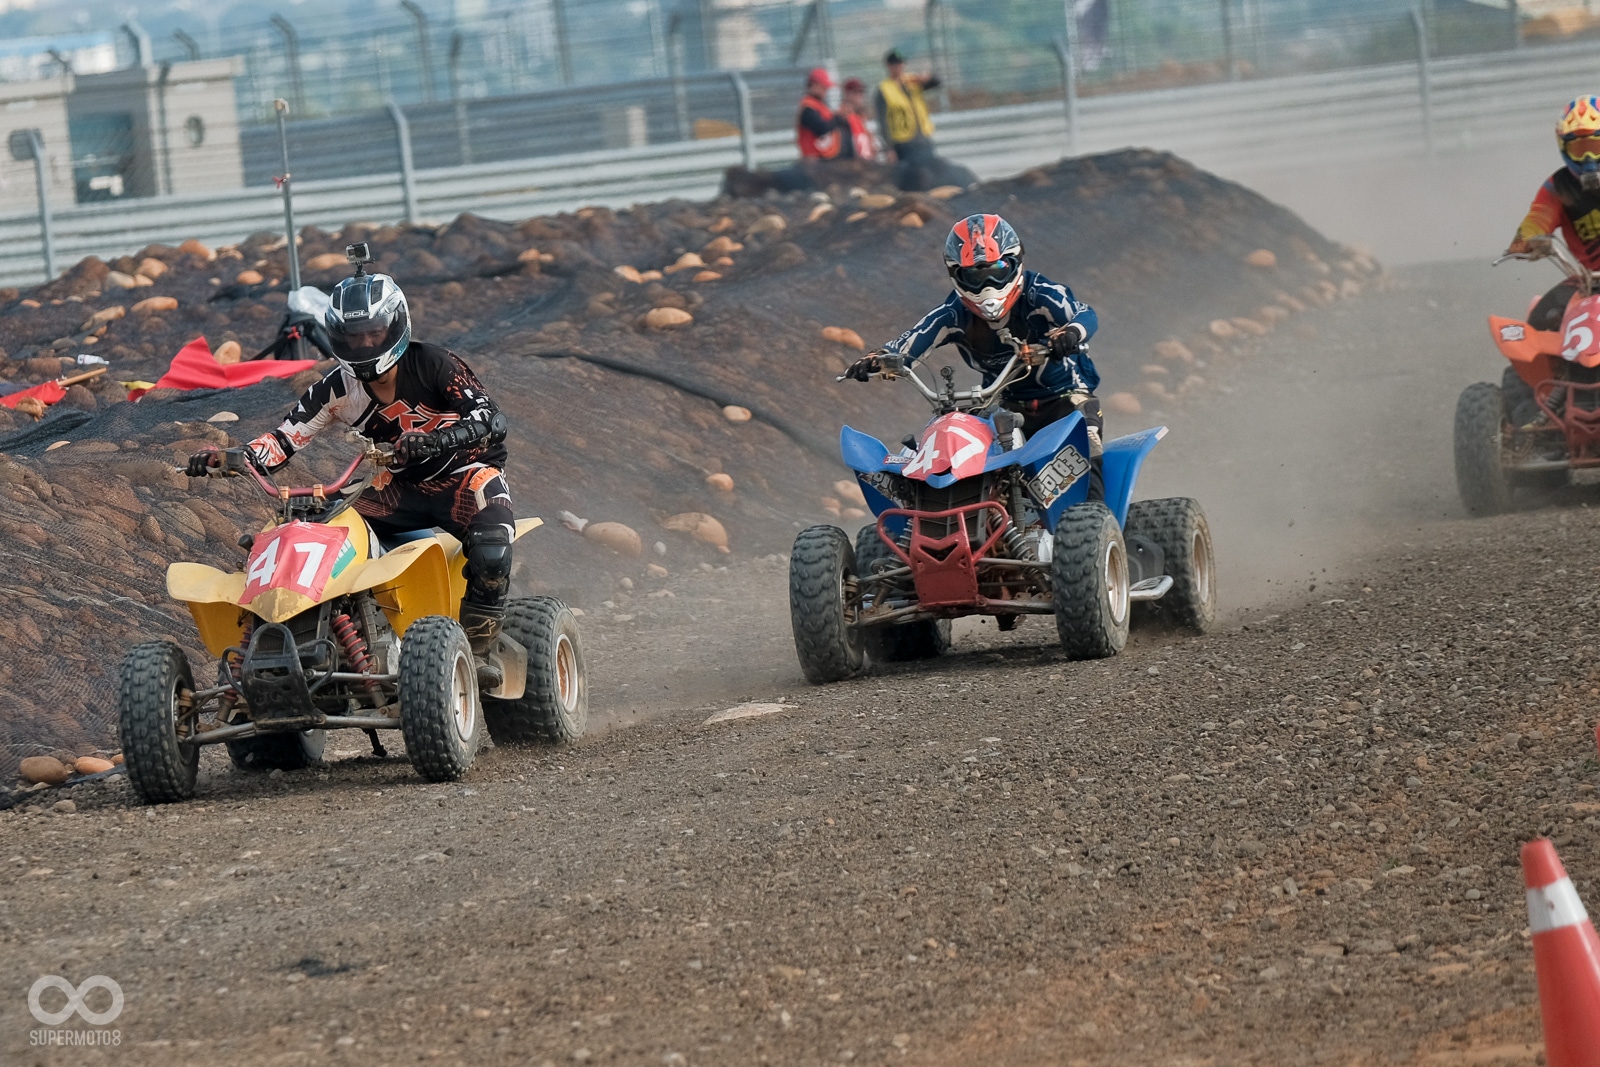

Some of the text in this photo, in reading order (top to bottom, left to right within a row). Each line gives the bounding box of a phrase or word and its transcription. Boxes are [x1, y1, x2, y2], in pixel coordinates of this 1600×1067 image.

[343, 309, 369, 319] SOL
[1562, 312, 1600, 361] 5
[902, 425, 985, 477] 47
[246, 536, 328, 589] 47
